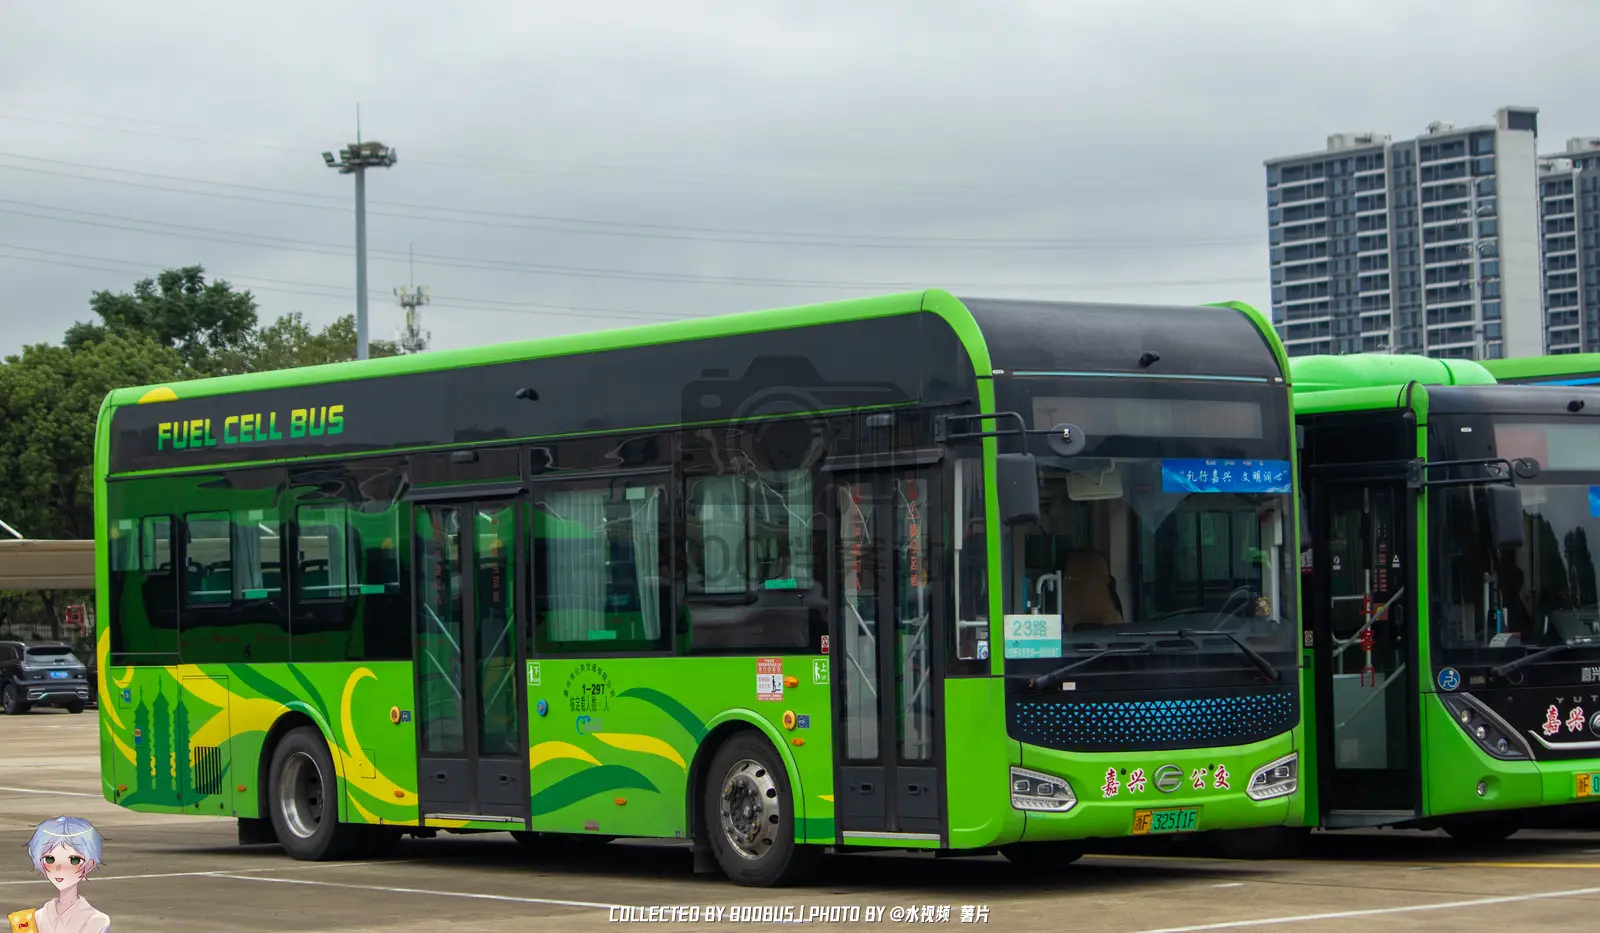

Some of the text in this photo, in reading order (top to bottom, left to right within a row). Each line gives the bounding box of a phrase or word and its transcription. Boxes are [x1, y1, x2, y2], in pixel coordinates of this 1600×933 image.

[157, 404, 344, 451] FUEL CELL BUS
[1012, 619, 1048, 638] 23路
[581, 683, 606, 696] 1-297
[1542, 704, 1586, 736] 嘉兴
[1101, 763, 1231, 797] 嘉兴 公交
